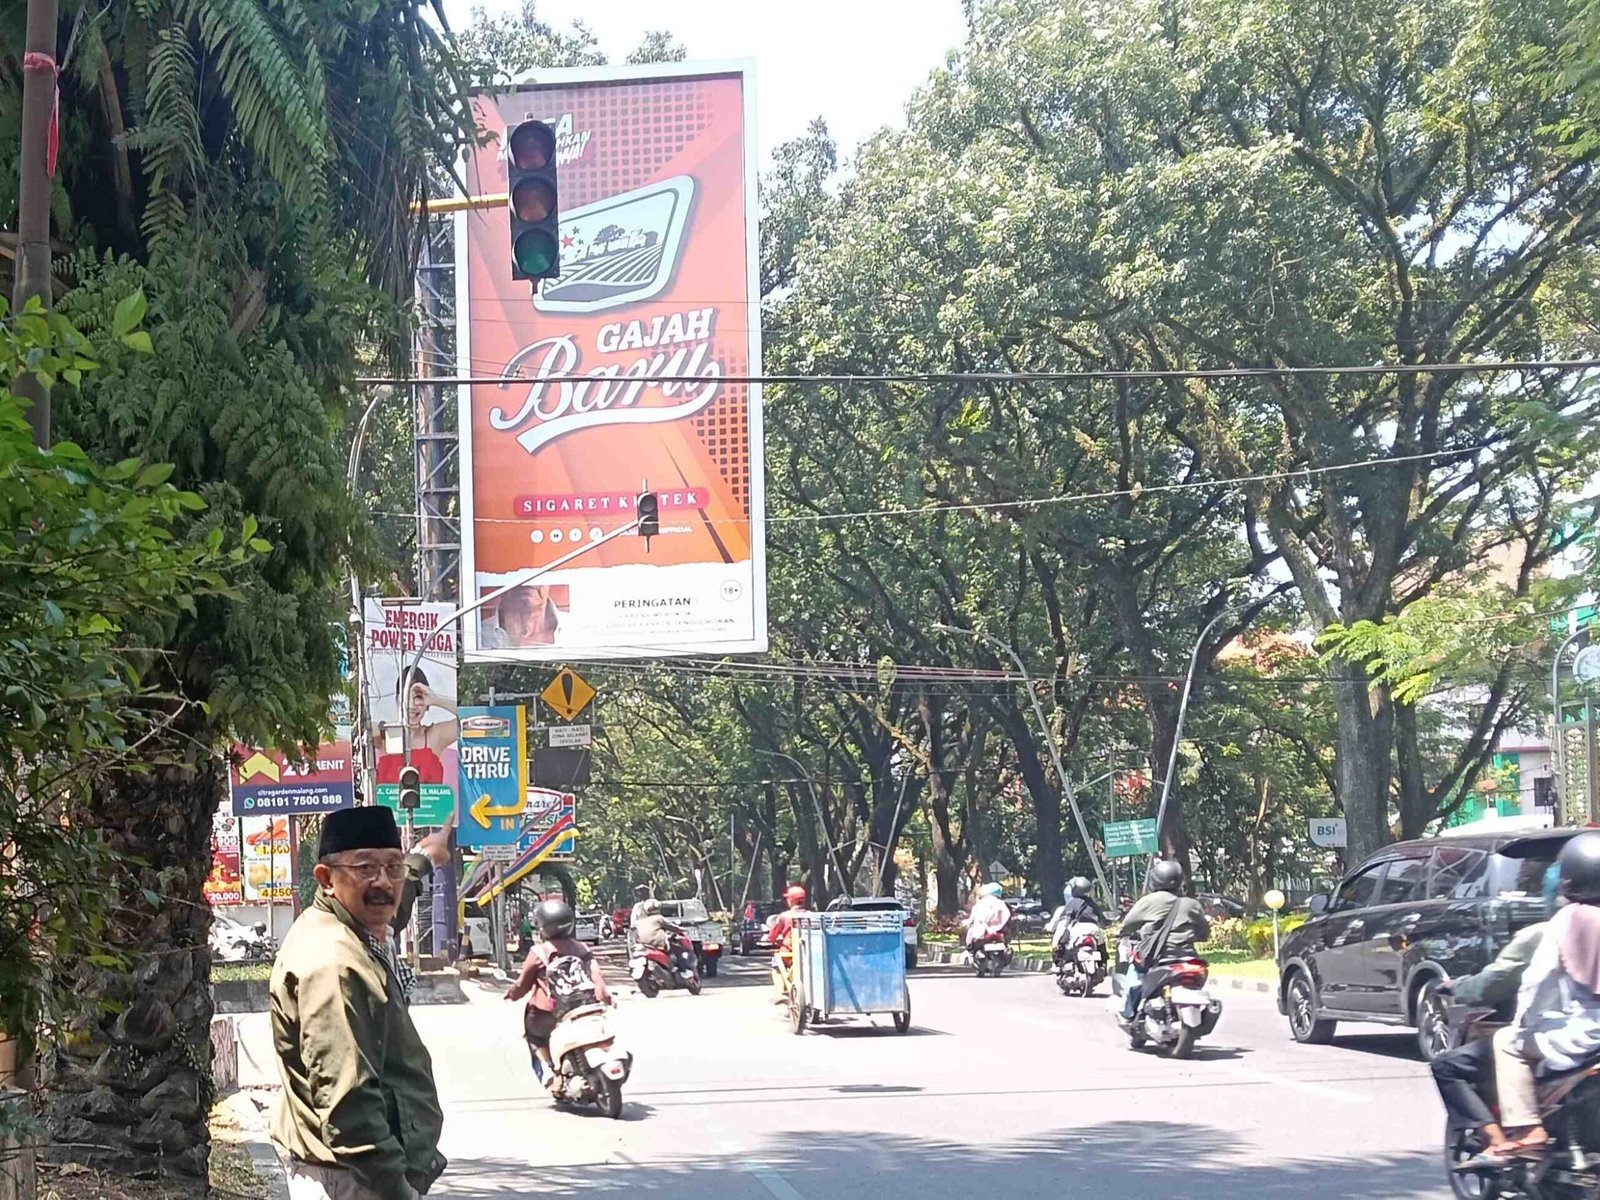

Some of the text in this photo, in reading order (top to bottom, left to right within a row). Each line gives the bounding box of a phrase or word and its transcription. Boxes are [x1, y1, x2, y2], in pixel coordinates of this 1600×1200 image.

[597, 308, 714, 353] GAJAH
[489, 333, 721, 453] Baru
[522, 491, 698, 513] SIGARET KTEK
[614, 597, 692, 609] PERINGATAN
[385, 609, 440, 631] ENERGIK
[371, 629, 416, 652] POWER
[460, 746, 511, 763] DRIVE
[463, 762, 510, 779] THRU
[257, 787, 328, 797] citragardenmalang.com
[257, 794, 343, 808] 08191 7500 888
[500, 817, 515, 830] IN
[1317, 825, 1336, 836] BSI
